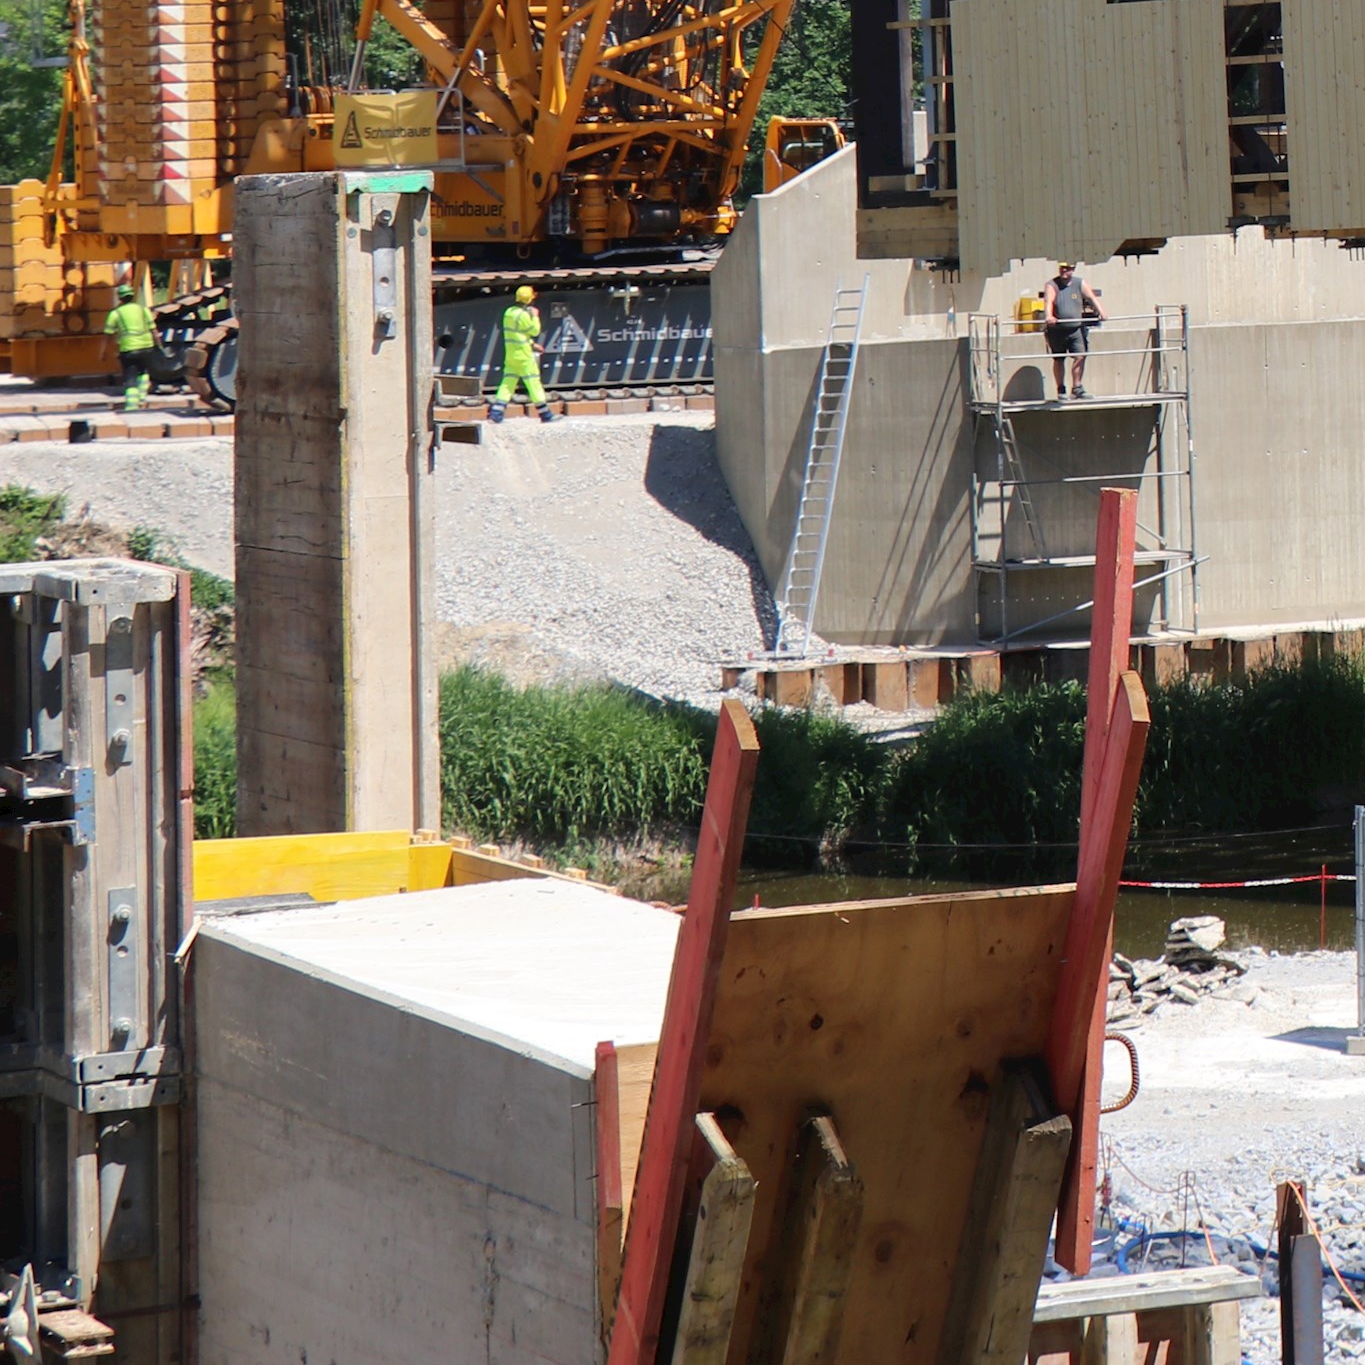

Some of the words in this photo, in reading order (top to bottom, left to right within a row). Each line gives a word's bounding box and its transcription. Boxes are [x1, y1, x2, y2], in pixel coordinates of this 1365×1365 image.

[364, 126, 432, 140] Schmidbauer
[431, 200, 504, 217] chmidbauer
[597, 327, 713, 342] Schmidbaue
